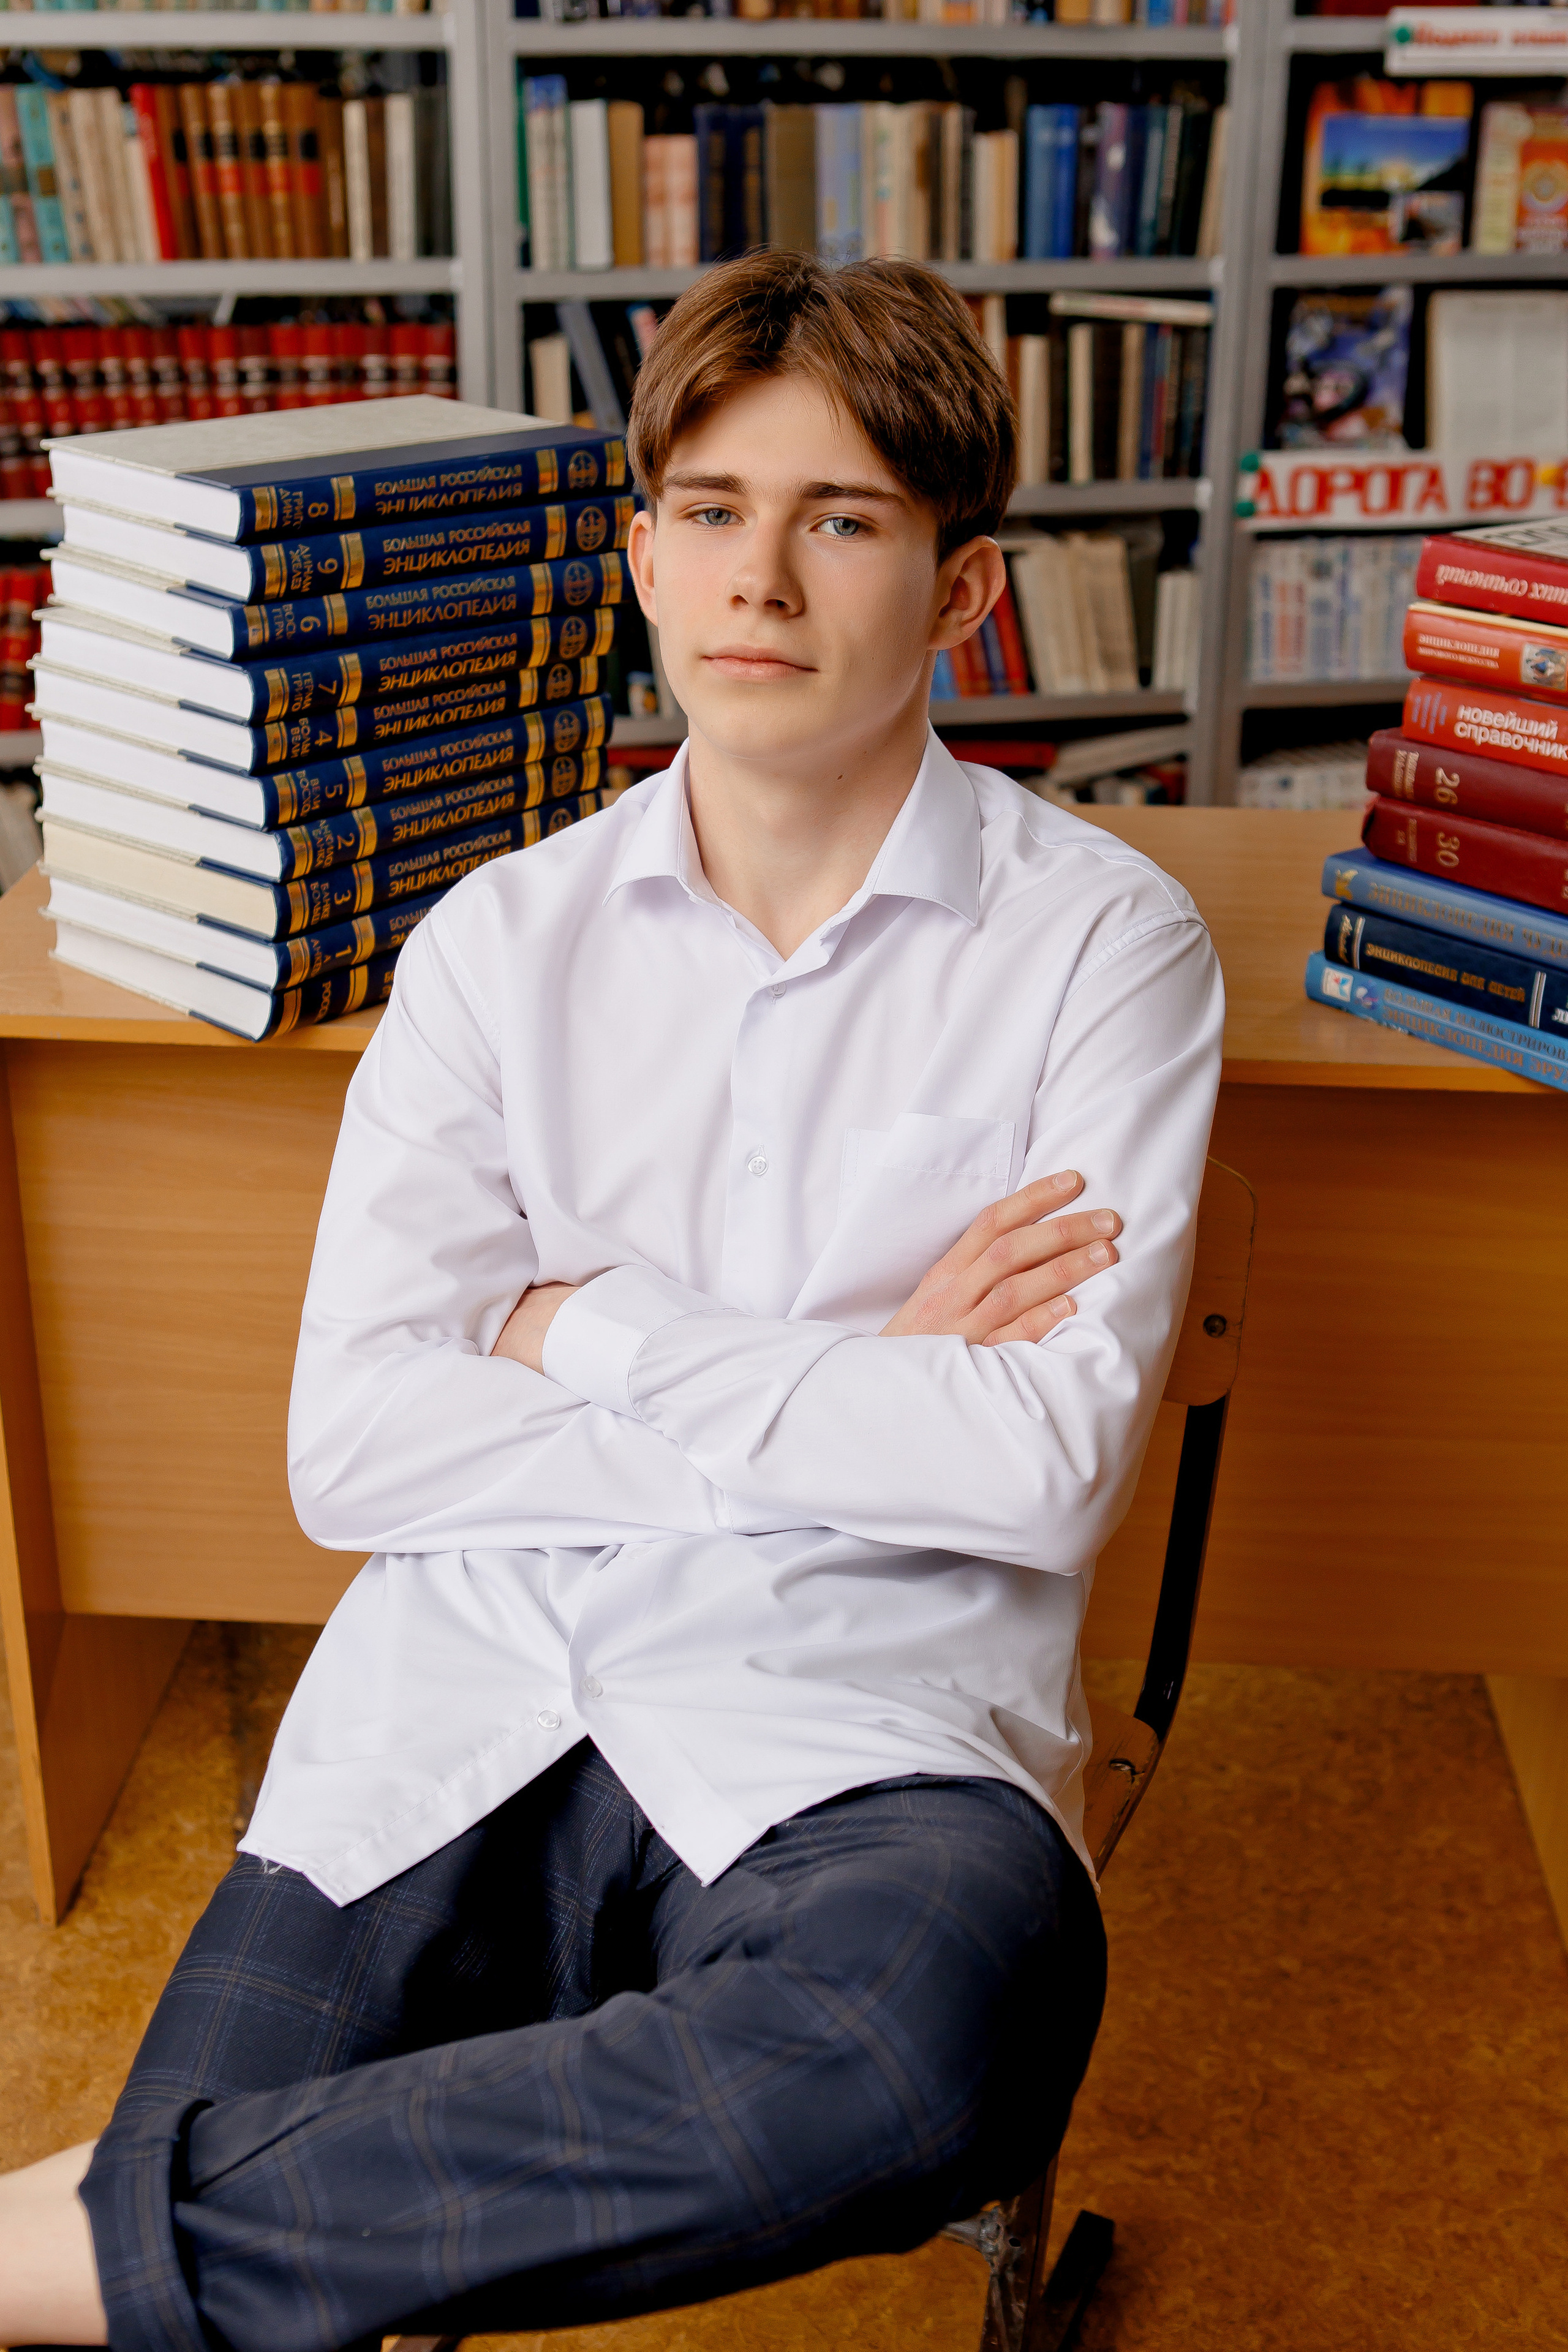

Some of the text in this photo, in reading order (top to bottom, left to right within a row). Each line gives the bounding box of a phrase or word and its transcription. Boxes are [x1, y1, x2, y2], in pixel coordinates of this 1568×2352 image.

[375, 464, 522, 496] БОЛЬШАЯ РОССИЙСКАЯ
[308, 502, 329, 518] 8
[383, 521, 531, 552] БОЛЬШАЯ РОССИЙСКАЯ
[289, 549, 303, 590] ЖЕЛЕЗ
[317, 558, 337, 574] 9
[383, 538, 531, 575] ЭНЦИКЛОПЕДИЯ
[366, 575, 516, 609] БОЛЬШАЯ РОССИЙСКАЯ
[1435, 564, 1528, 597] сочинений
[300, 616, 321, 632] 6
[368, 594, 517, 631] ЭНЦИКЛОПЕДИЯ
[379, 633, 518, 671] БОЛЬШАЯ РОССИЙСКАЯ
[318, 680, 337, 695] 7
[378, 650, 517, 693] ЭНЦИКЛОПЕДИЯ
[373, 680, 506, 720] БОЛЬШАЯ РОССИЙСКАЯ
[314, 730, 333, 746] 4
[1457, 704, 1558, 740] новейший
[382, 728, 513, 772] БОЛЬШАЯ РОССИЙСКАЯ
[1454, 721, 1568, 761] справочник
[383, 745, 514, 793] ЭНЦИКЛОПЕДИЯ
[1434, 766, 1460, 805] 26
[325, 783, 344, 799] 5
[390, 775, 514, 821] БОЛЬШАЯ РОССИЙСКАЯ
[393, 792, 515, 842] ЭНЦИКЛОПЕДИЯ
[337, 832, 355, 850] 2
[388, 829, 511, 876] БОЛЬШАЯ РОССИЙСКАЯ
[1435, 831, 1461, 869] 30
[334, 889, 352, 905] 3
[1368, 883, 1515, 942] ЭНЦИКЛОПЕДИЯ
[323, 954, 331, 963] А
[335, 944, 353, 958] 1
[1382, 1005, 1525, 1067] ЭНЦИКЛОПЕДИЯ
[1384, 987, 1452, 1021] БОЛЬШАЯ
[1455, 1012, 1568, 1061] ИЛЛЮСТРИРОВ
